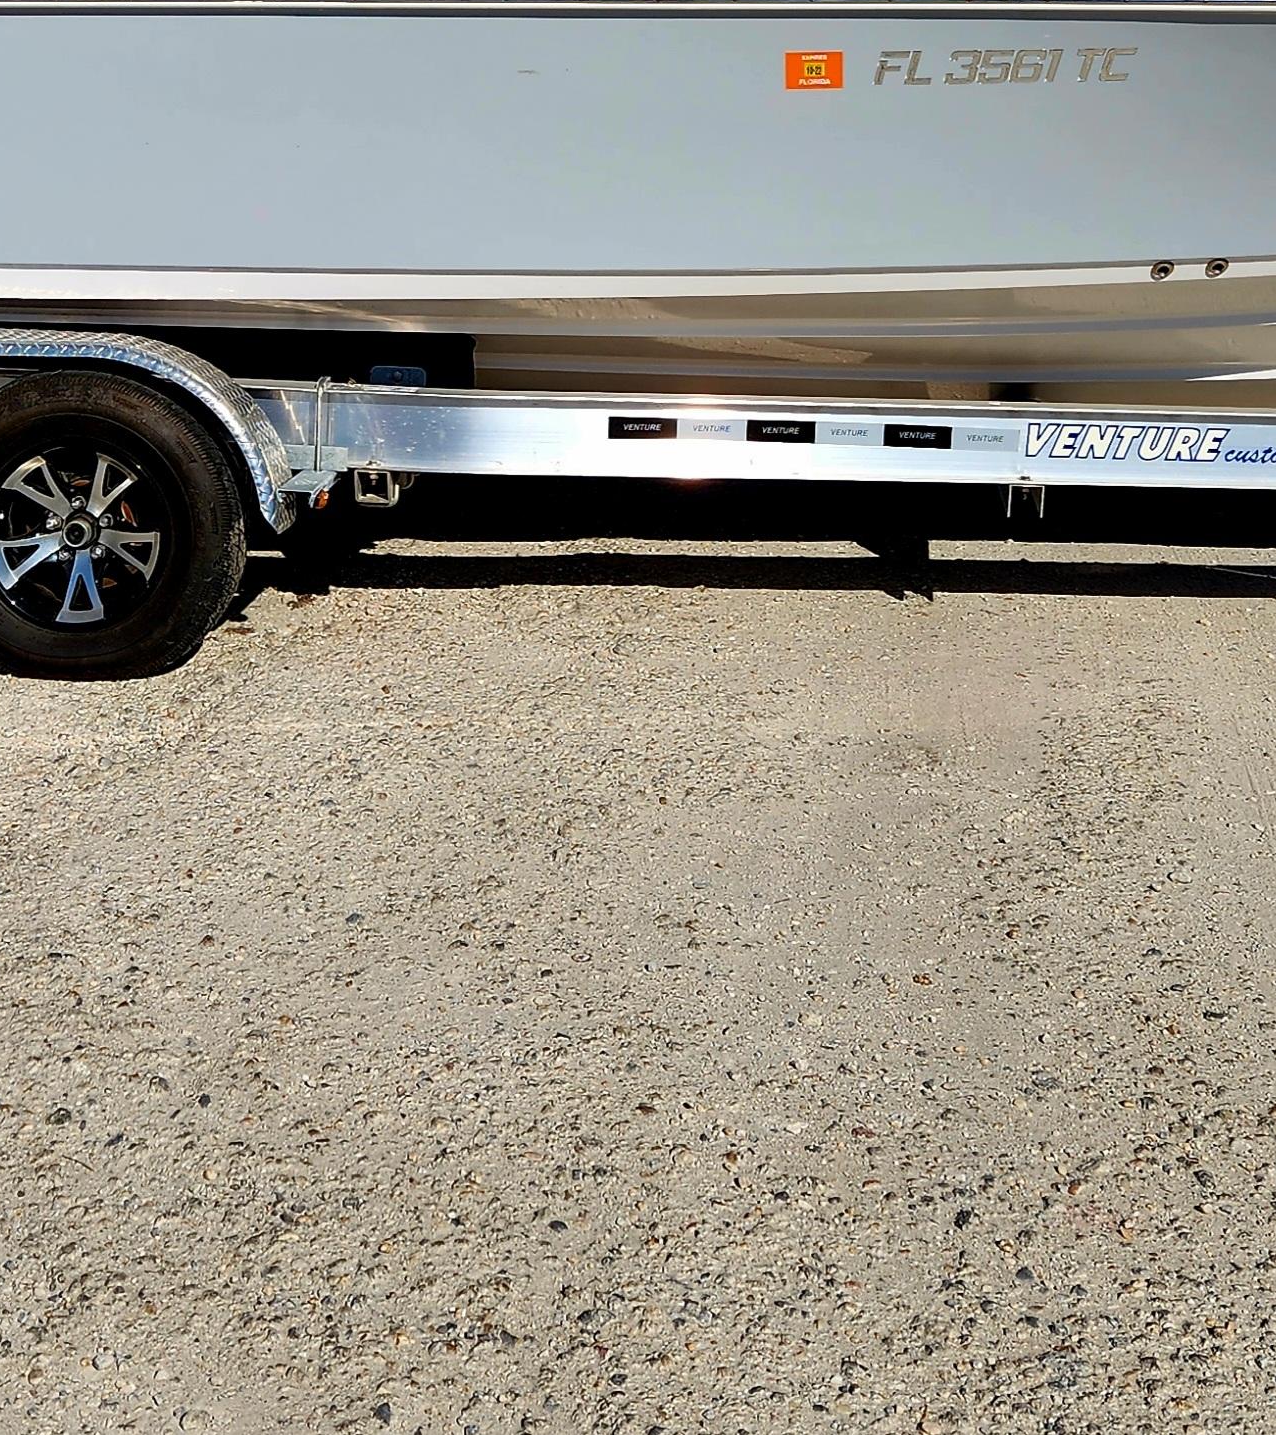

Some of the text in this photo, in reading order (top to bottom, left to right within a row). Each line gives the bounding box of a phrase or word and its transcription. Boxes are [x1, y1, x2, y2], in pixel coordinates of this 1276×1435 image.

[873, 47, 1138, 85] FL 3561 TC
[623, 423, 1005, 443] VENTURE VENTURE VENTURE VENTURE VENTURE VENTURE
[1025, 423, 1231, 462] VENTURE
